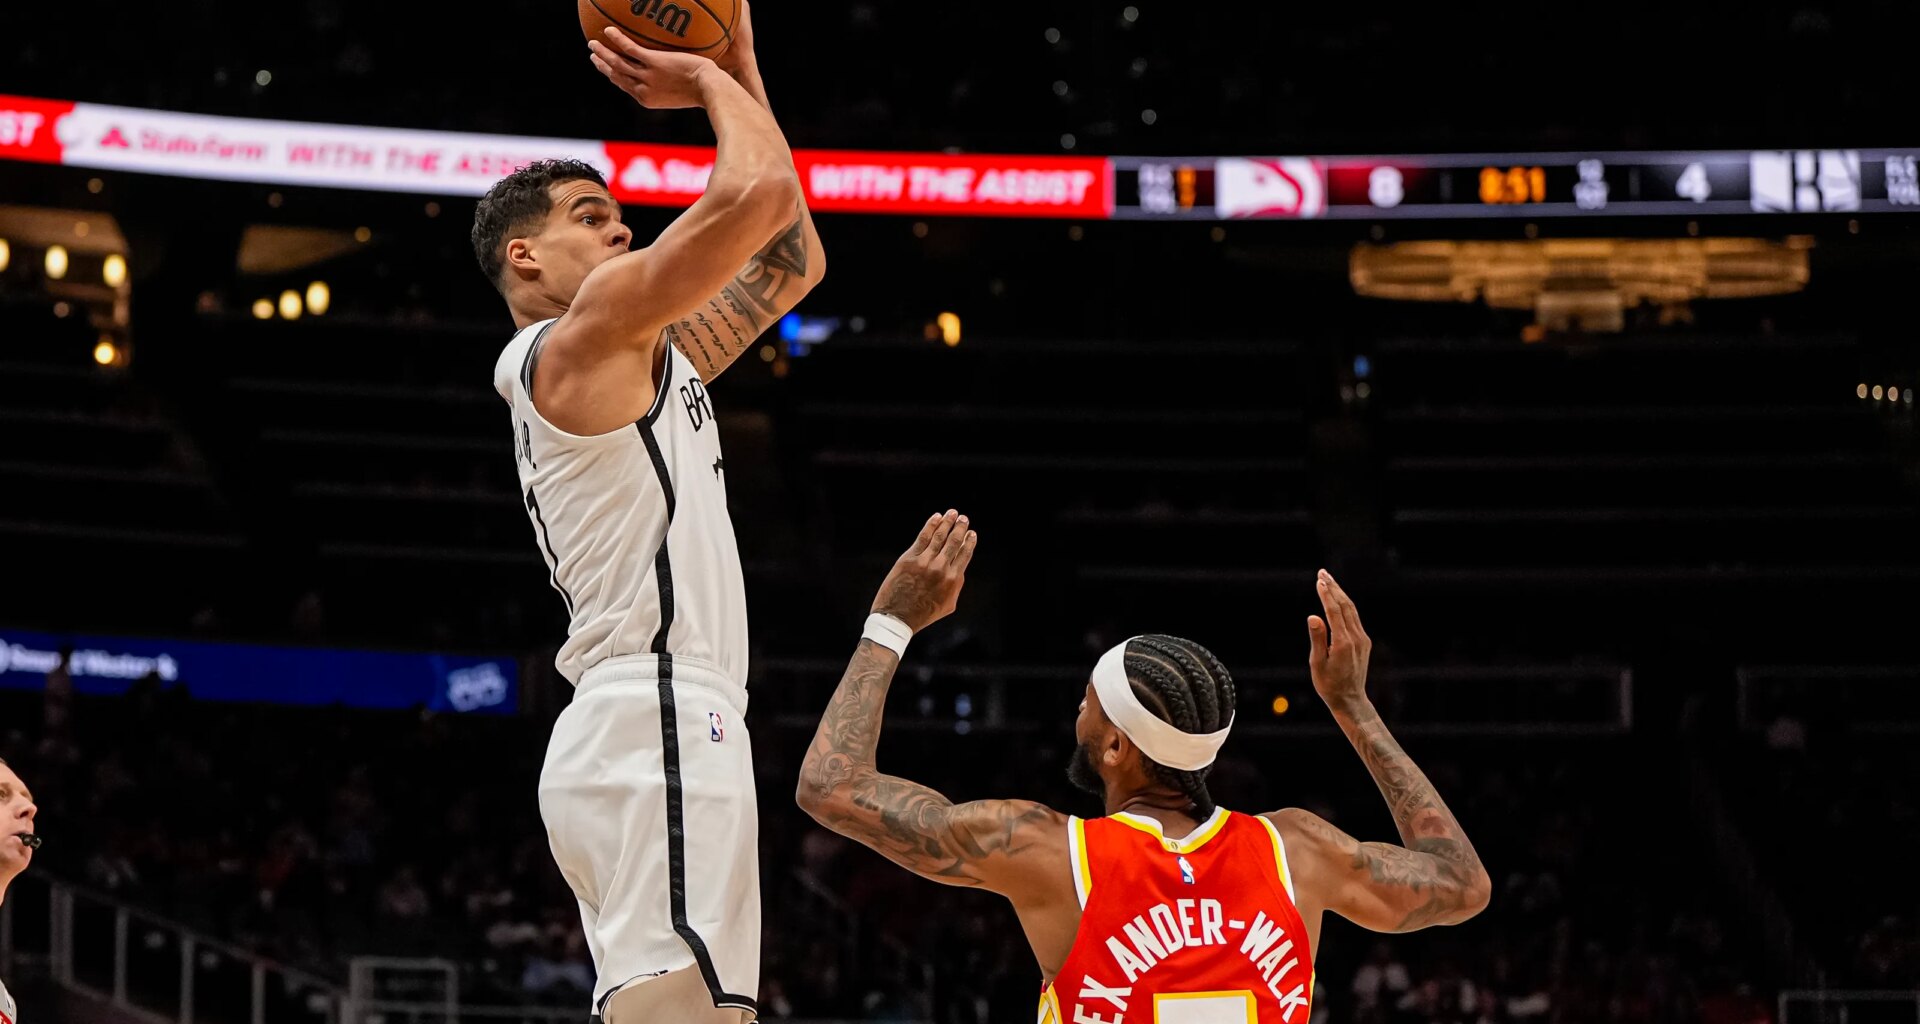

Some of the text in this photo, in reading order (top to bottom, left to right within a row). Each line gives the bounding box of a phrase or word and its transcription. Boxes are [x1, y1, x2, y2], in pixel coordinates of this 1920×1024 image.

[287, 138, 374, 167] WITH
[387, 144, 441, 173] THE
[809, 163, 905, 202] WITH
[907, 166, 976, 204] THE
[974, 168, 1095, 206] ASSIST
[1368, 165, 1404, 208] 8
[1676, 161, 1711, 203] 4
